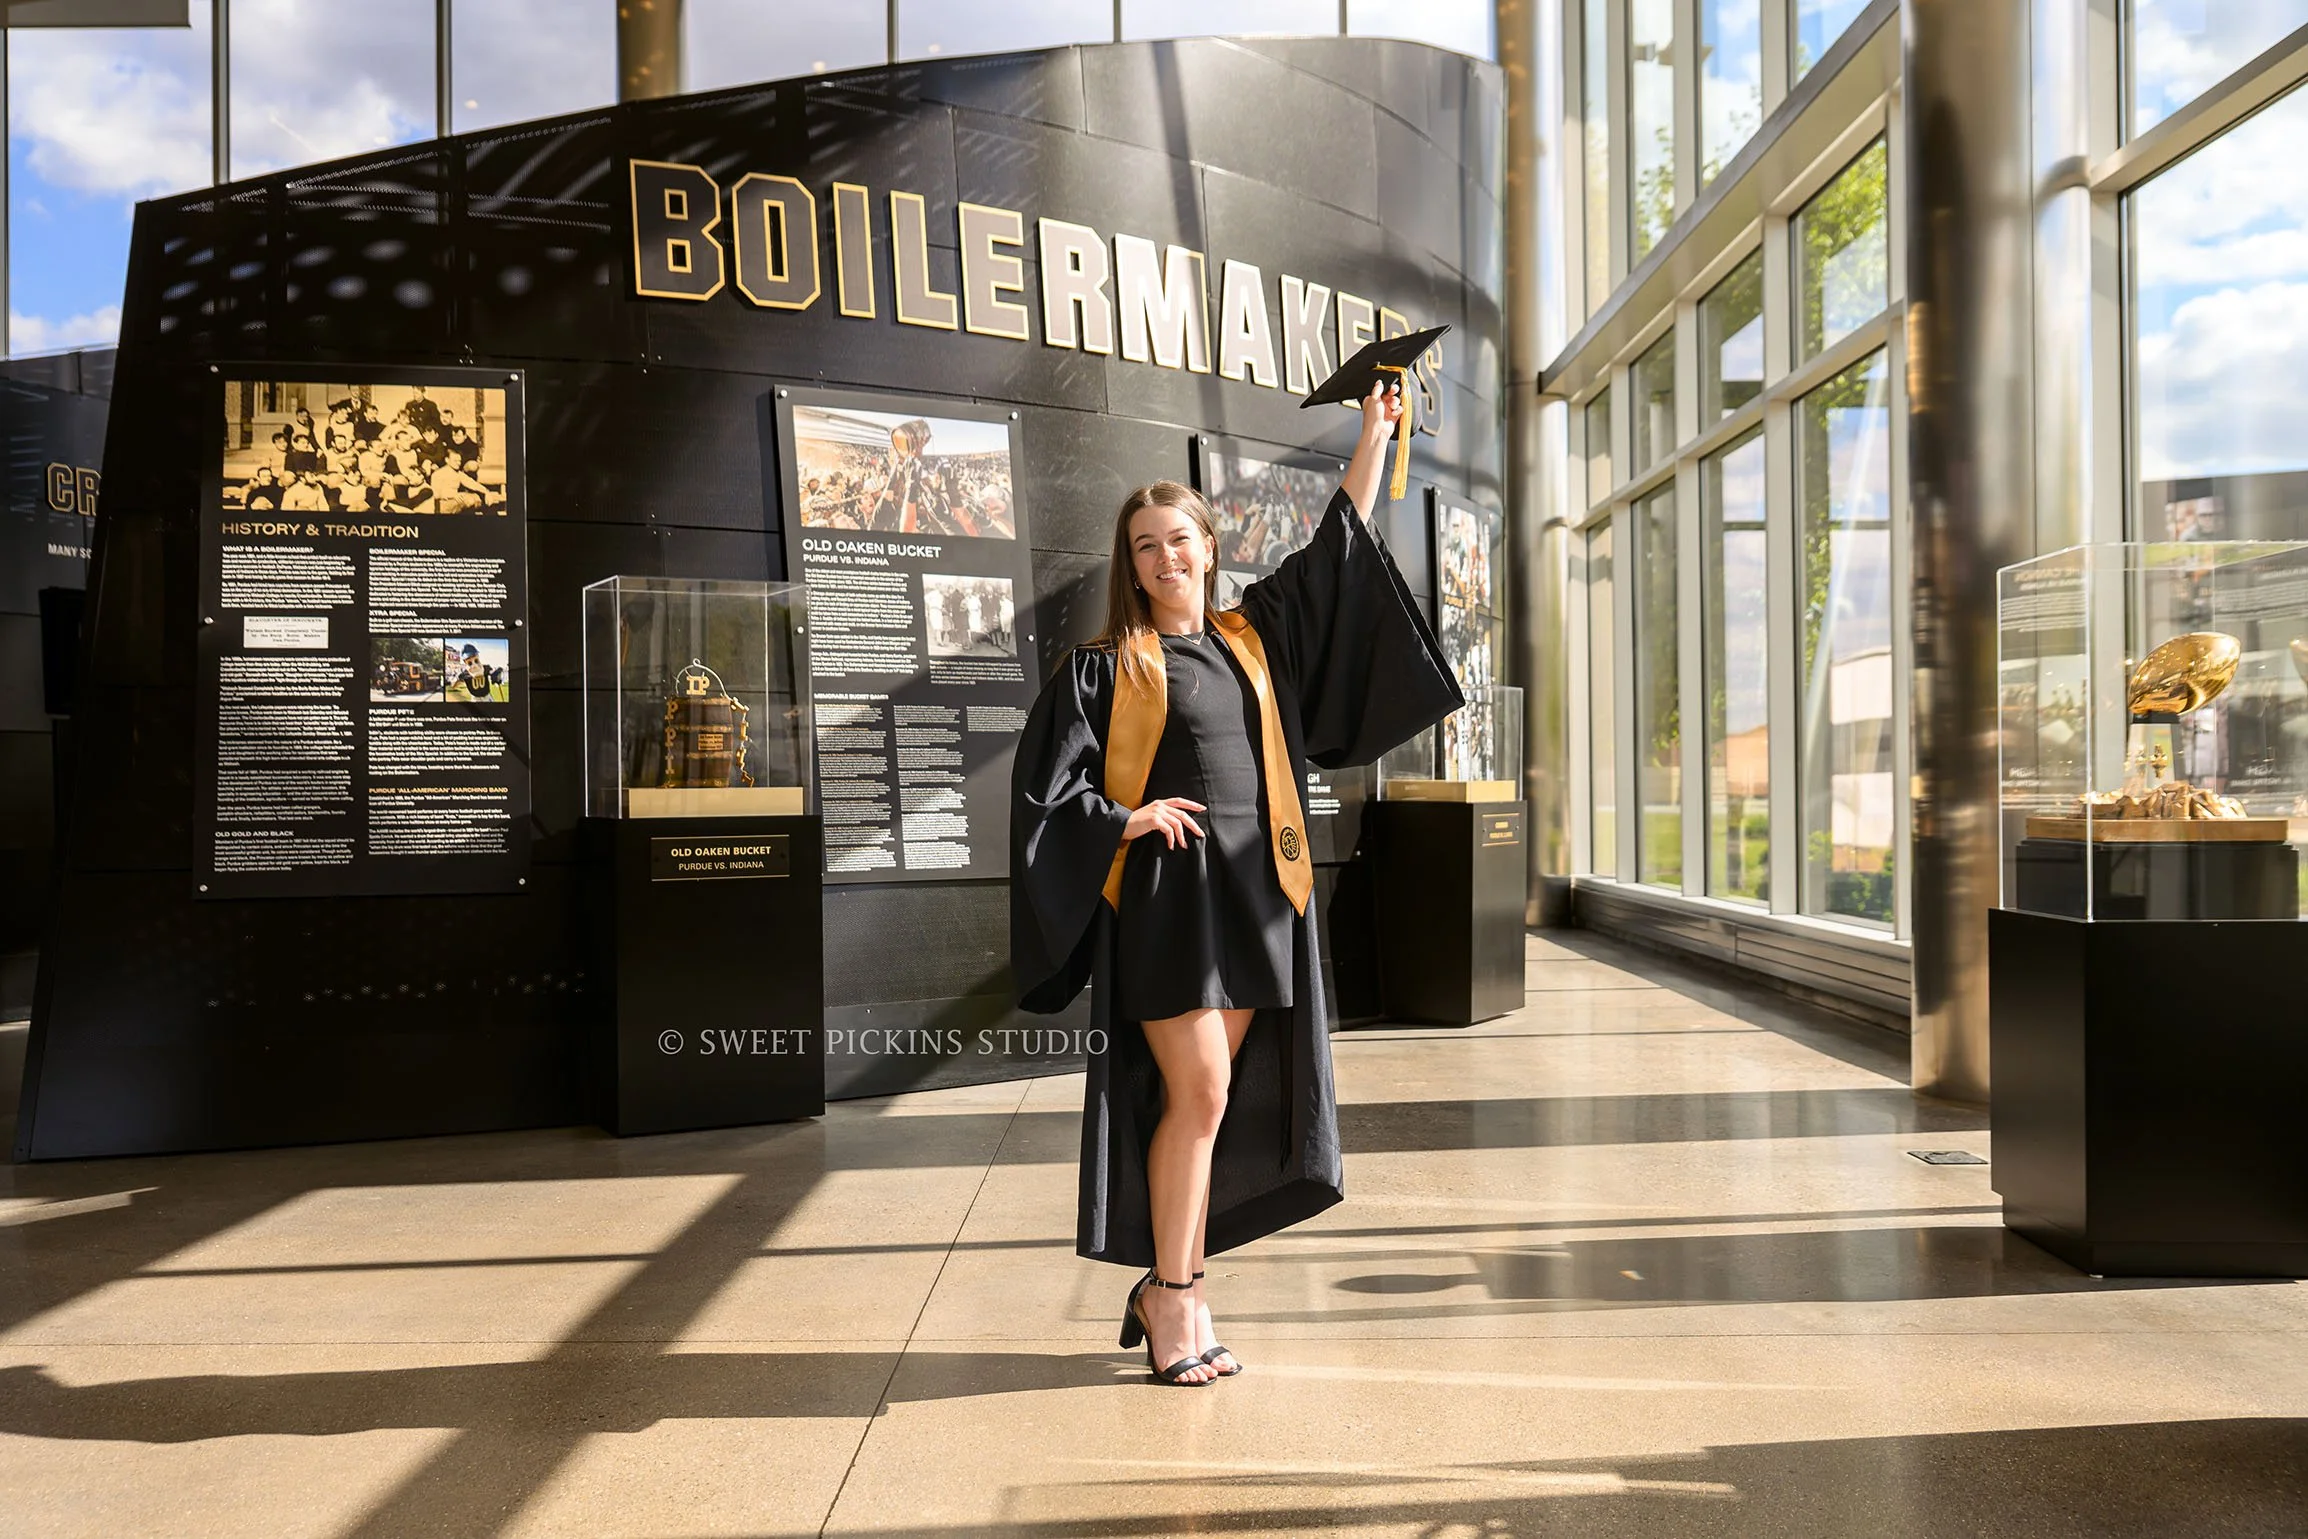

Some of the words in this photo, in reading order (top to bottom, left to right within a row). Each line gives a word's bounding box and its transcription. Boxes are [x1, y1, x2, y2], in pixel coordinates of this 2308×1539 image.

[222, 522, 300, 536] HISTORY
[305, 523, 320, 537] &
[325, 524, 419, 538] TRADITION
[48, 543, 77, 557] MANY
[802, 538, 832, 552] OLD
[836, 540, 885, 555] OAKEN
[887, 542, 942, 558] BUCKET
[803, 553, 838, 564] PURDUE
[854, 555, 890, 567] INDIANA
[671, 848, 692, 857] OLD
[694, 847, 731, 857] OAKEN
[732, 845, 771, 856] BUCKET
[678, 862, 712, 871] PURDUE
[714, 861, 728, 870] VS.
[729, 861, 764, 870] INDIANA
